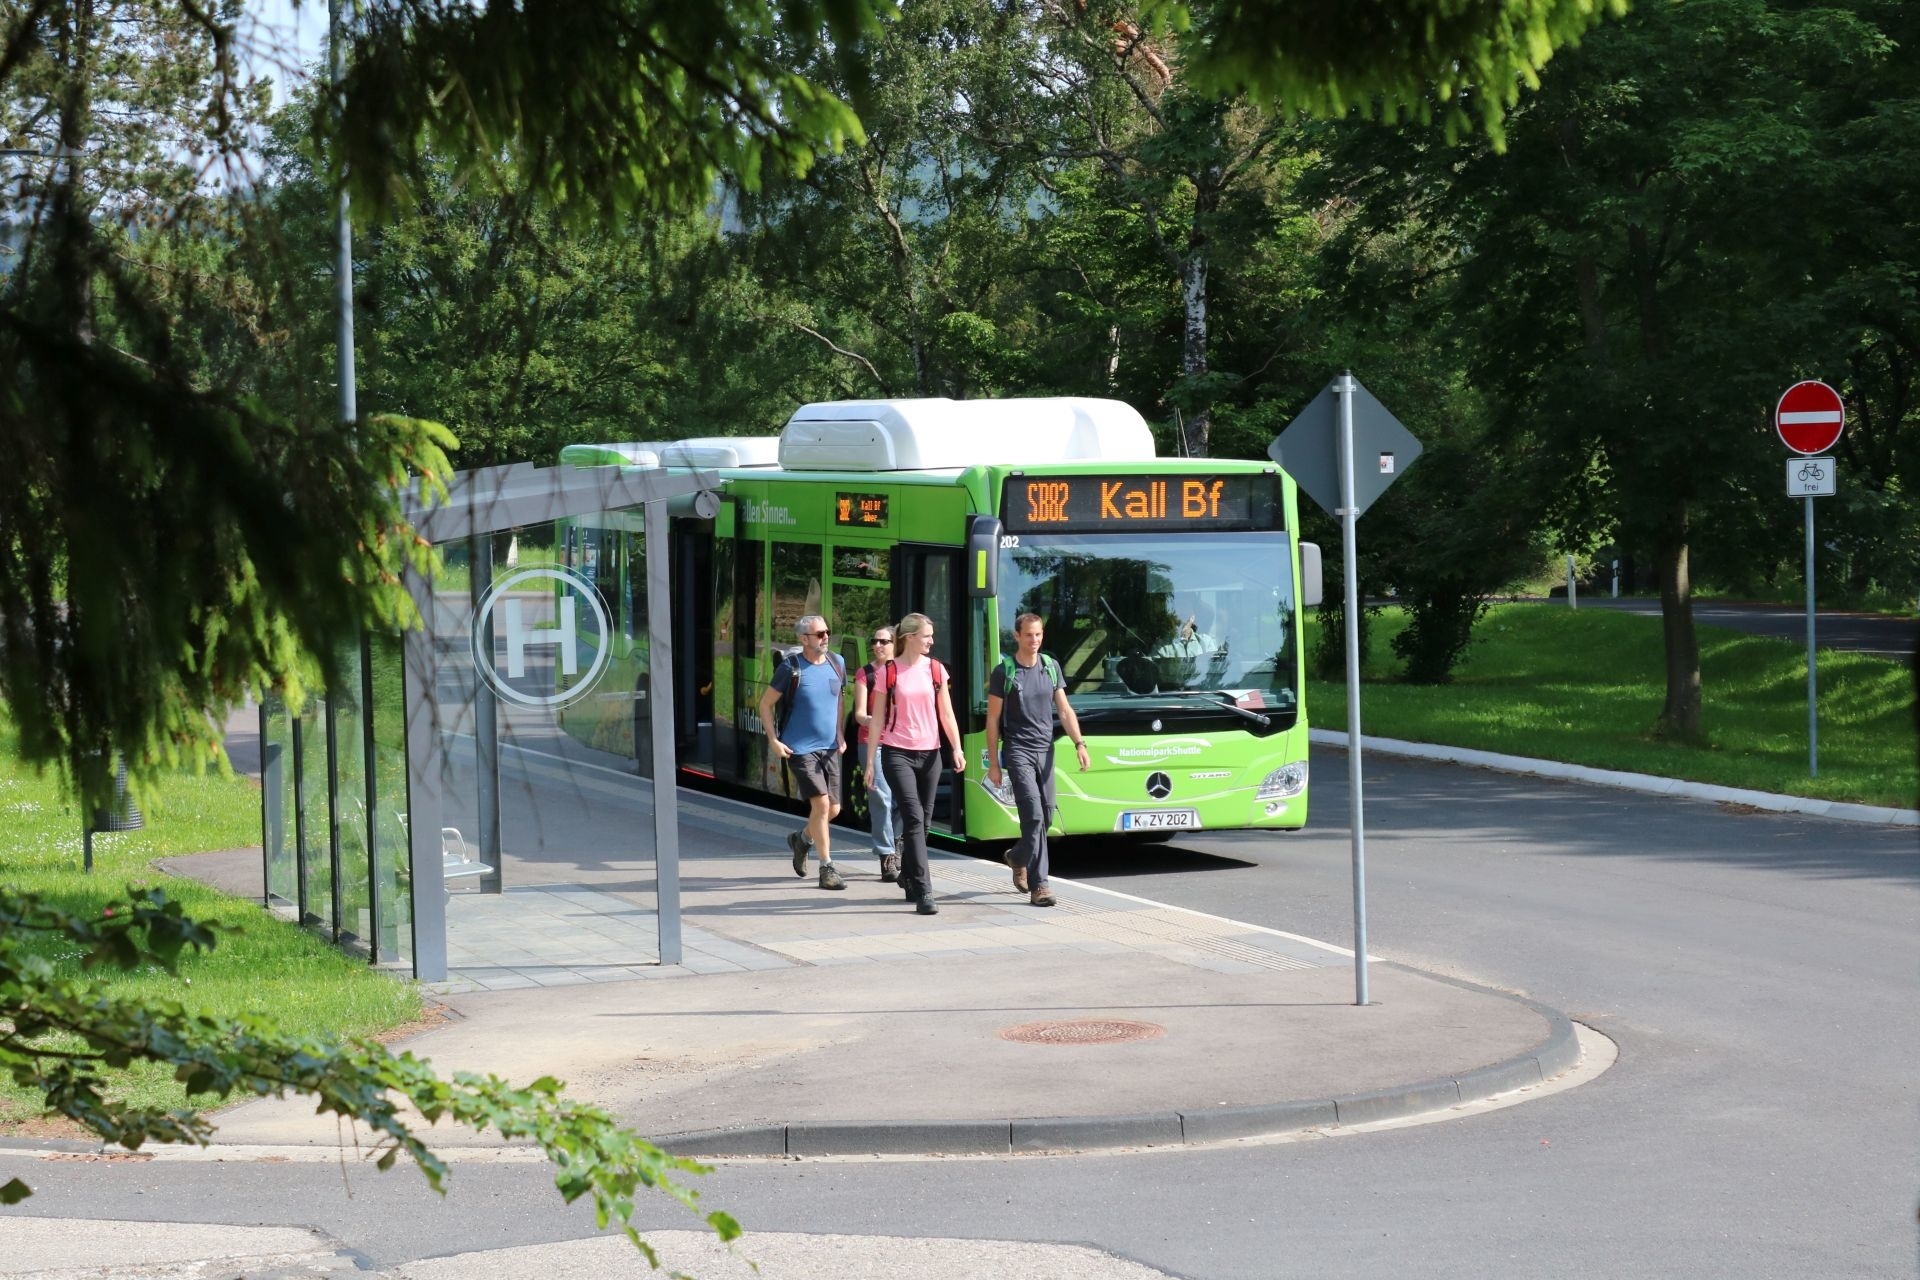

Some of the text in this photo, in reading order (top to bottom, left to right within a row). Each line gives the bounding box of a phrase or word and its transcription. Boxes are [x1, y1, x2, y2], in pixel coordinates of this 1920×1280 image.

[1804, 482, 1819, 492] frei
[1028, 481, 1224, 521] SB82 Kall Bf
[1000, 535, 1020, 549] 202
[505, 596, 578, 678] H
[1119, 745, 1203, 758] NationalparkShuttle
[1134, 813, 1188, 827] K ZY 202
